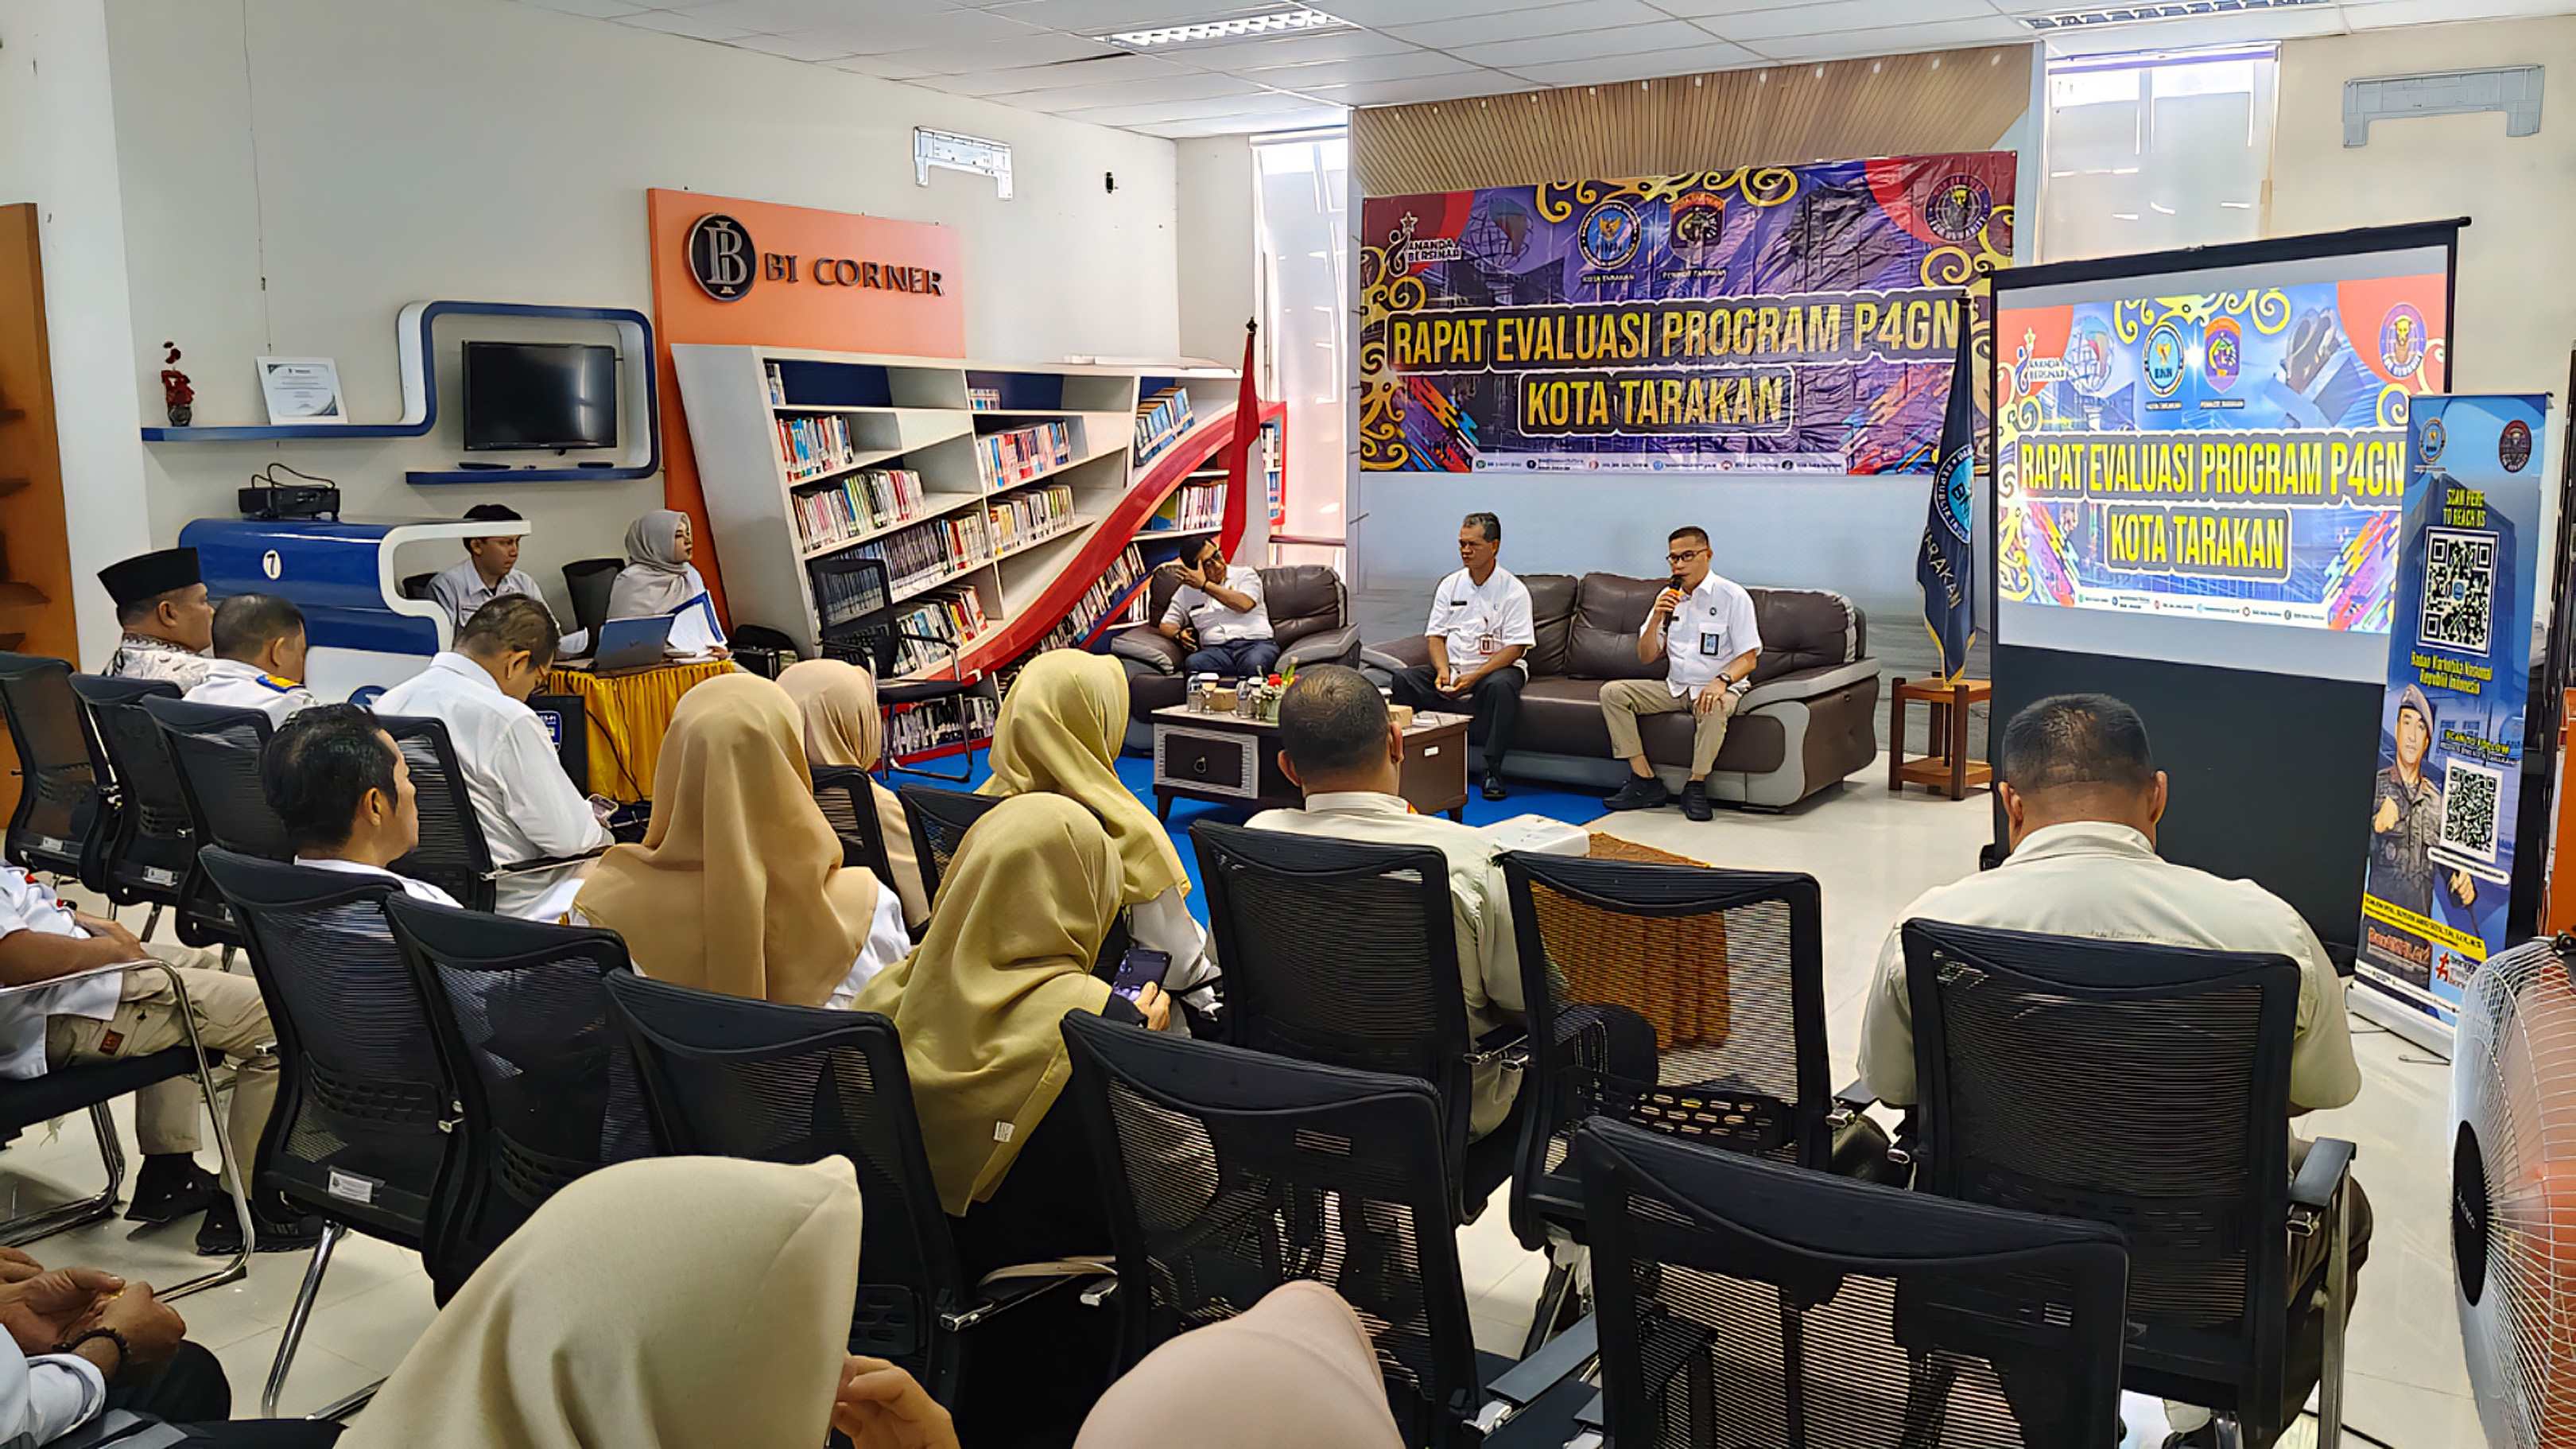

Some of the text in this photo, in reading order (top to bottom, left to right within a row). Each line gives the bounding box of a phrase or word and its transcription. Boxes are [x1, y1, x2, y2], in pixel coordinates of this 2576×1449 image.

[766, 252, 945, 297] BI CORNER
[1394, 298, 1959, 365] RAPAT EVALUASI PROGRAM P4GN
[1527, 376, 1783, 426] KOTA TARAKAN
[2021, 441, 2406, 497] RAPAT EVALUASI PROGRAM P4GN
[267, 554, 276, 575] 7
[1922, 526, 1961, 608] ARAKAN
[2111, 514, 2284, 569] KOTA TARAKAN
